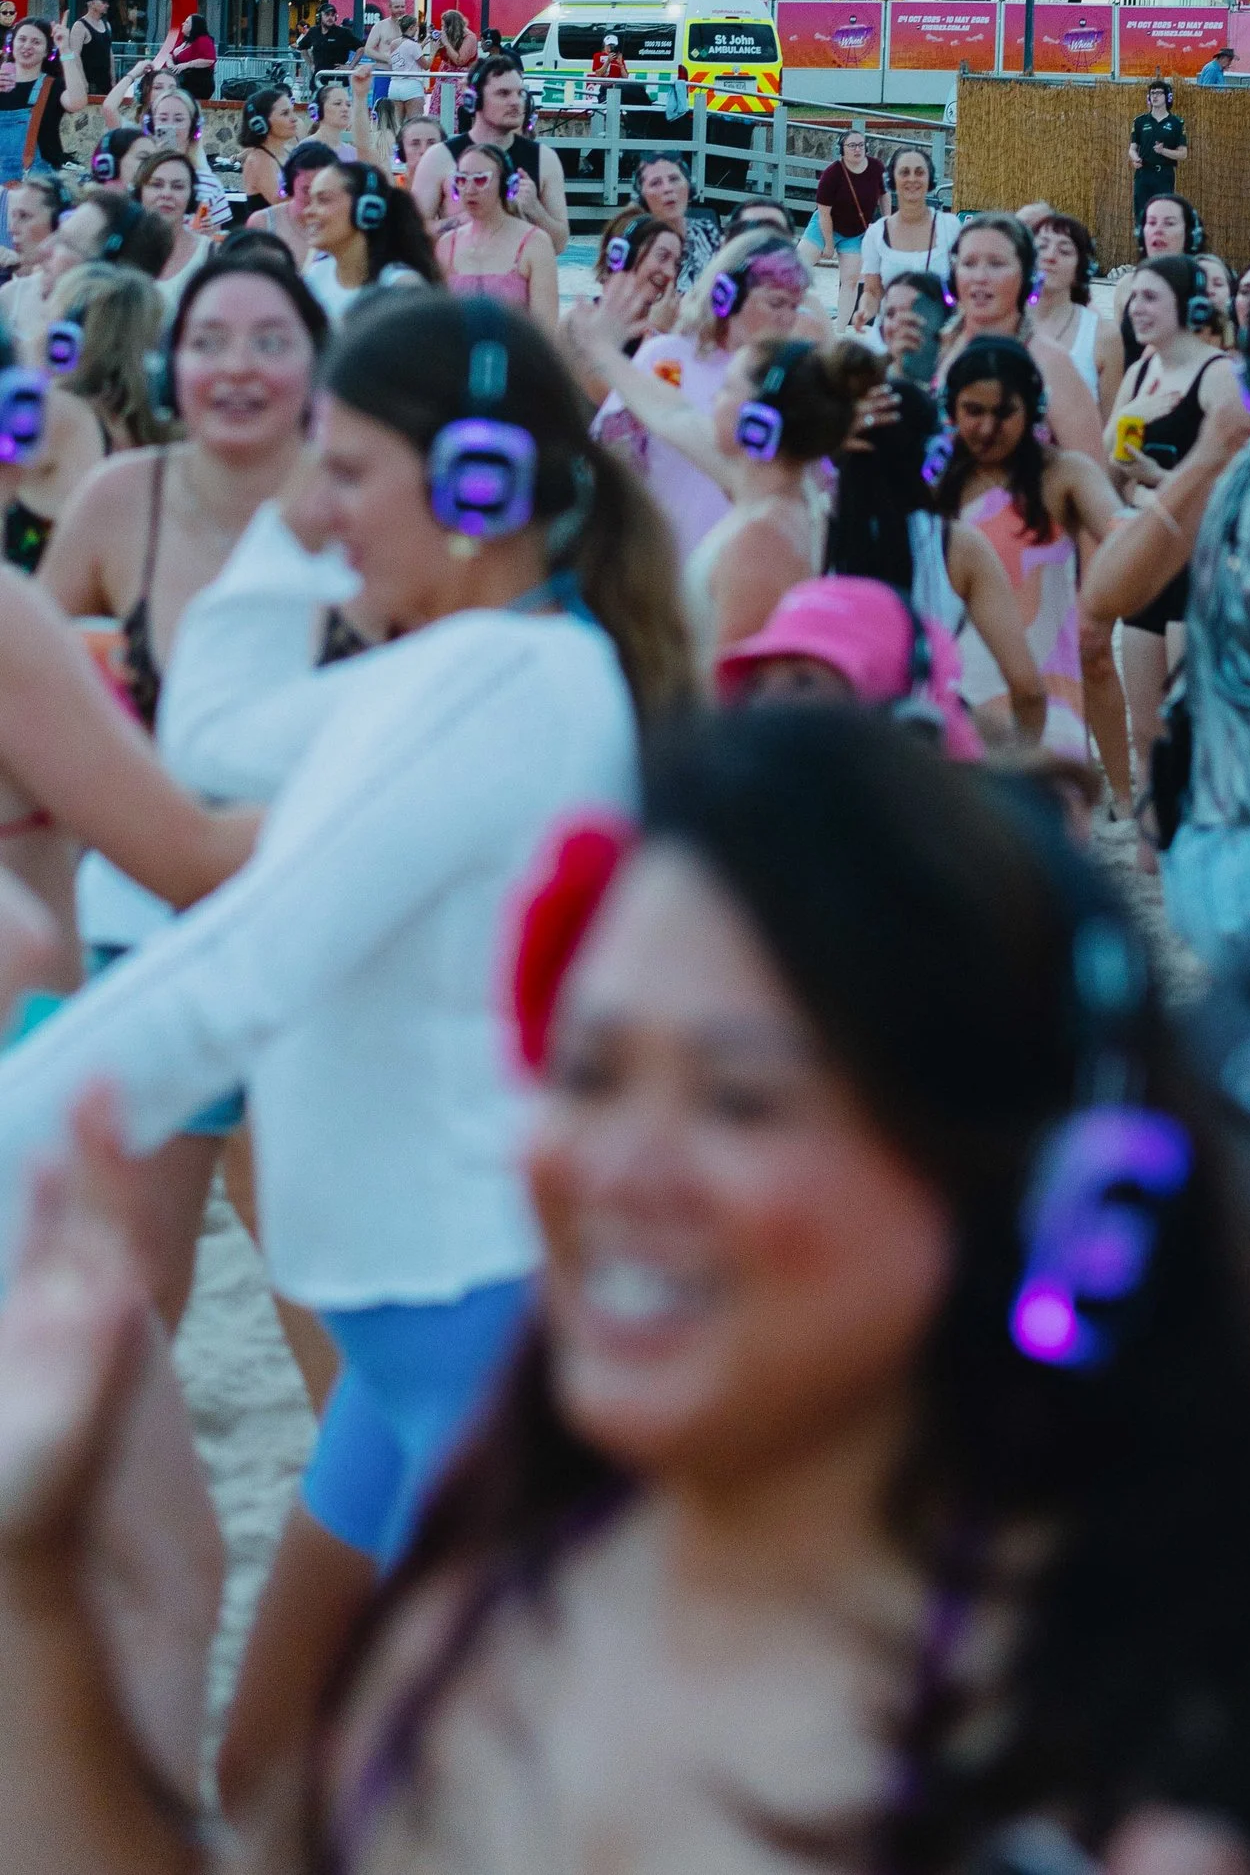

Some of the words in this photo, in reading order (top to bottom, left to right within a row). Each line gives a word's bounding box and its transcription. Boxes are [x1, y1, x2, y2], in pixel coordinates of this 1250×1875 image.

[908, 15, 922, 23] OCT
[954, 16, 970, 24] MAY
[1138, 21, 1152, 29] OCT
[1186, 21, 1203, 29] MAY
[714, 34, 727, 45] St
[729, 34, 755, 45] John
[840, 35, 864, 47] Wheel
[1071, 39, 1094, 50] Wheel
[708, 46, 762, 55] AMBULANCE
